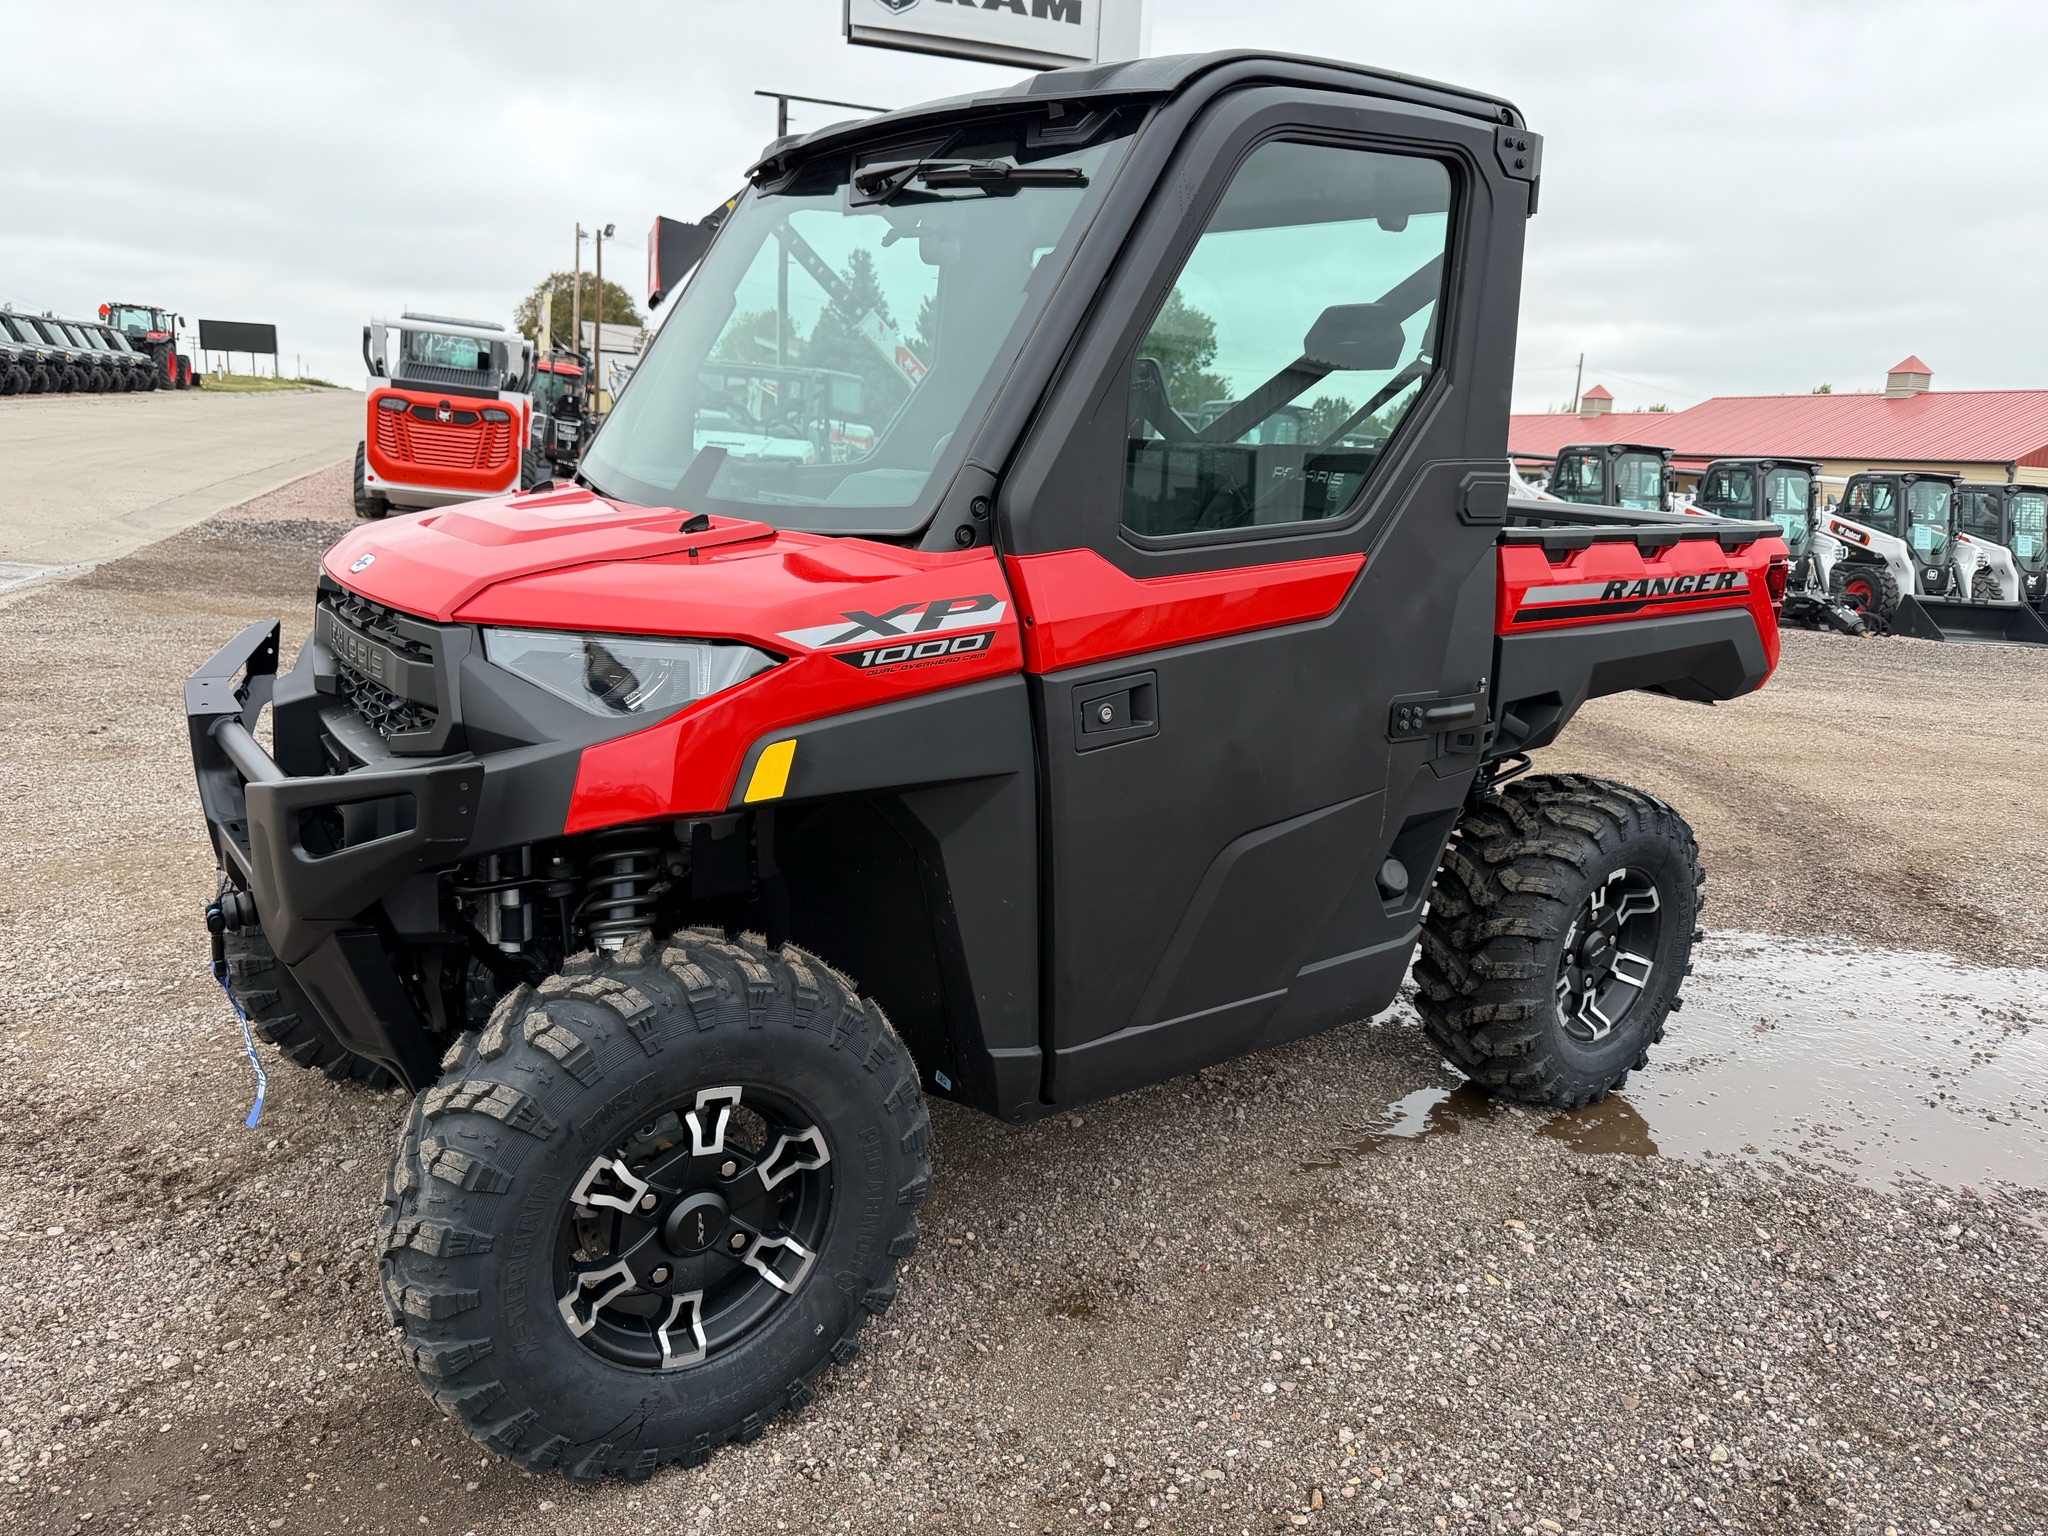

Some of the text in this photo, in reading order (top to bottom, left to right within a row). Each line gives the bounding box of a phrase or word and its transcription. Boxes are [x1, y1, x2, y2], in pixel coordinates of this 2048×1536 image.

[1600, 571, 1738, 600] RANGER
[818, 593, 1000, 646] XP
[860, 634, 986, 667] 1000
[865, 652, 987, 677] DUAL OVERHEAD CAM
